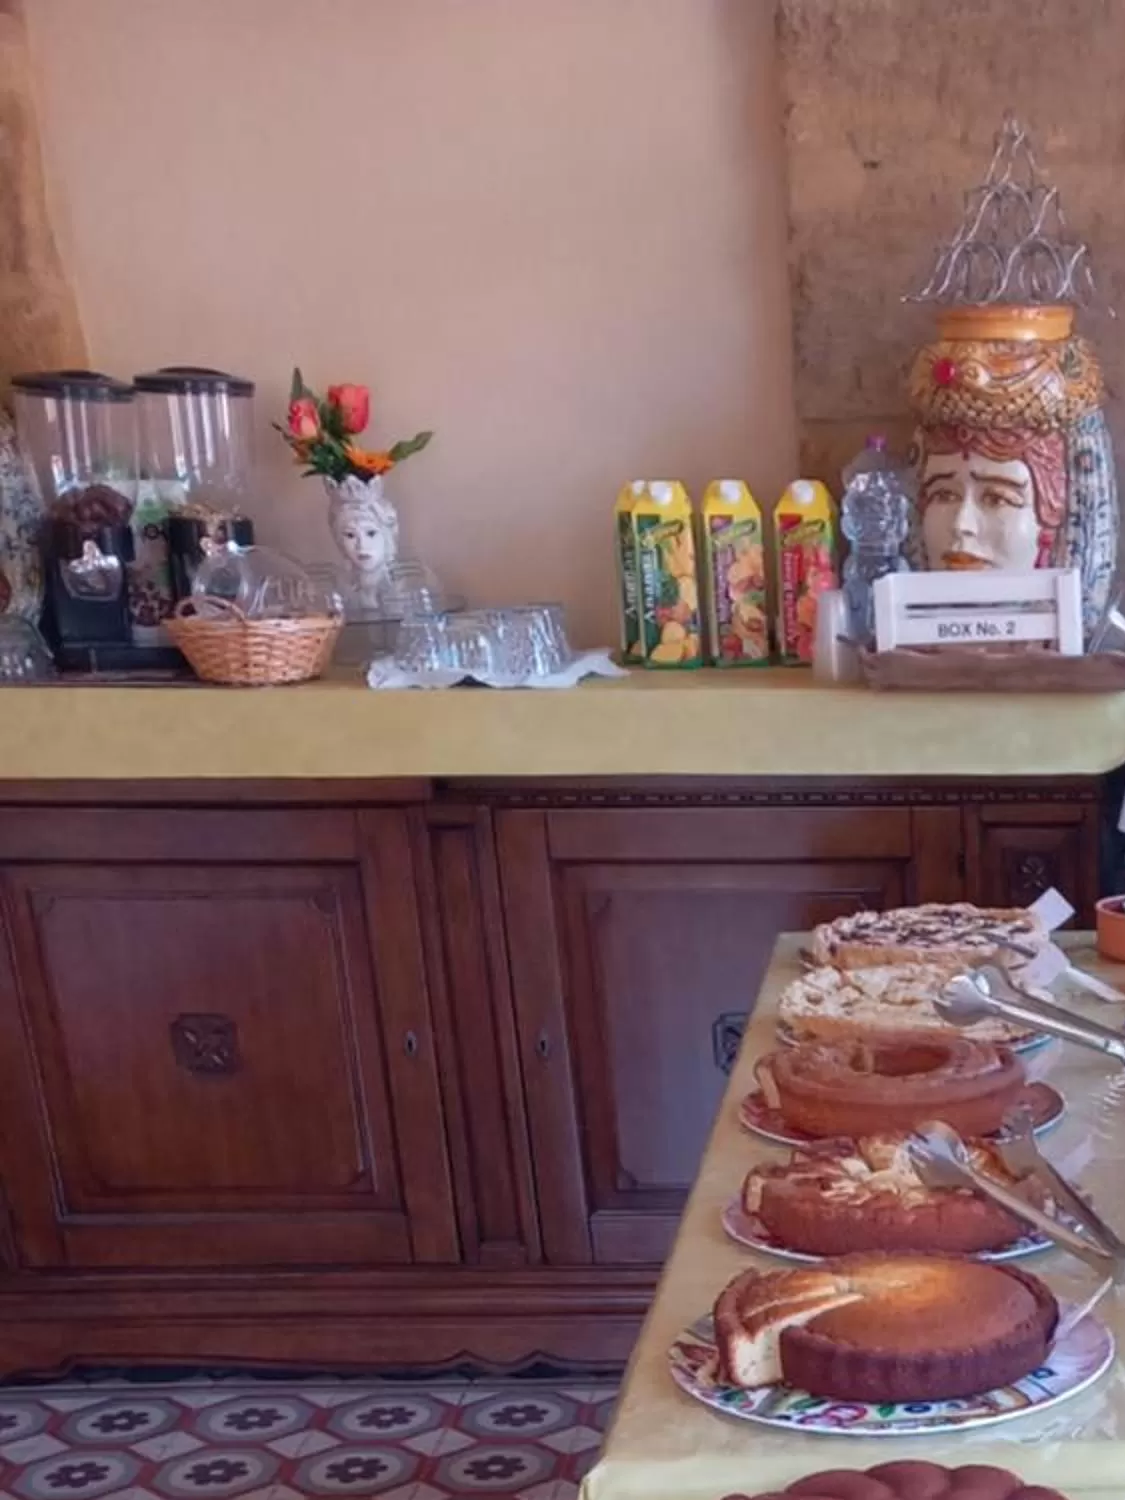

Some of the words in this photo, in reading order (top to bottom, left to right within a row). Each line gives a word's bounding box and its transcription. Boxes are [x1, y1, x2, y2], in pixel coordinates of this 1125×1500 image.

[937, 622, 974, 638] BOX
[976, 620, 1002, 637] No.
[1004, 620, 1017, 635] 2
